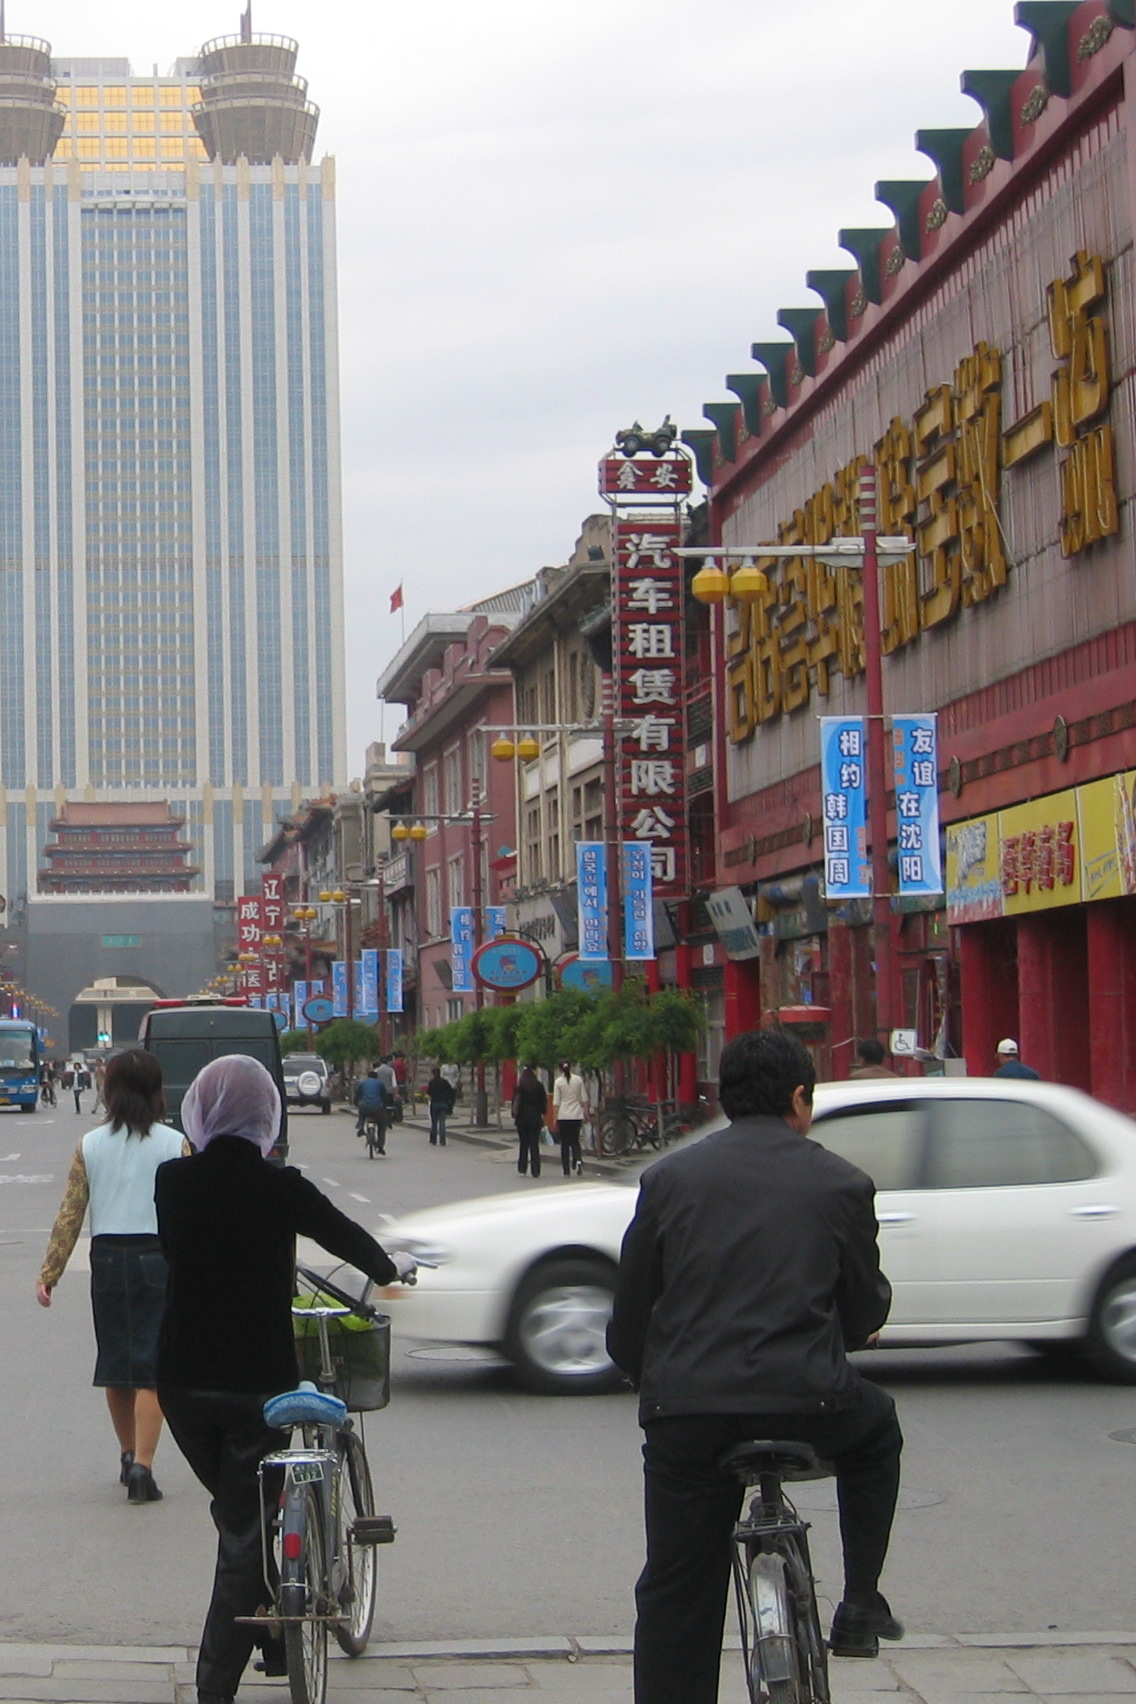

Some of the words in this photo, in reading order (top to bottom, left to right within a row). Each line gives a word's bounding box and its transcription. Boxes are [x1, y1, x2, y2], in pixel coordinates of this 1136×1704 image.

[616, 461, 679, 490] 鑫安
[625, 532, 676, 883] 汽车租赁有限公司
[825, 729, 862, 885] 相约韩国周
[898, 727, 936, 883] 友谊在沈阳
